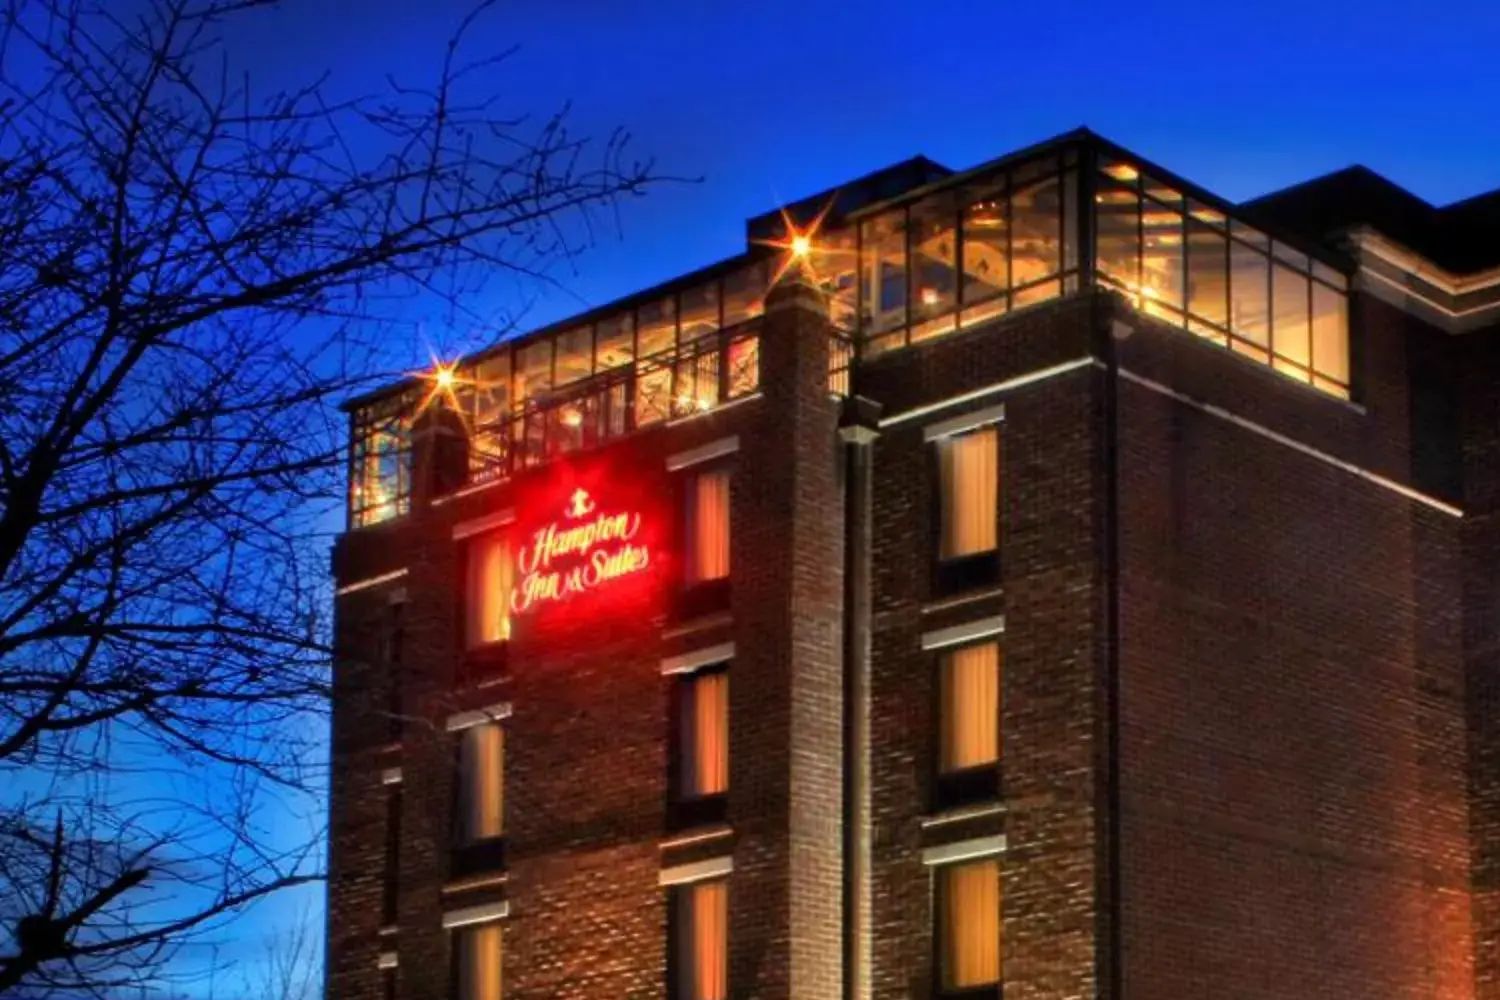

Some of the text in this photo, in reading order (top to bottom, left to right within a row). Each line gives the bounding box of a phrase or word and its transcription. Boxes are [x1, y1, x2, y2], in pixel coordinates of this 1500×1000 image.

[519, 512, 641, 575] Hampton
[511, 571, 570, 613] Inn
[582, 543, 649, 587] Suites
